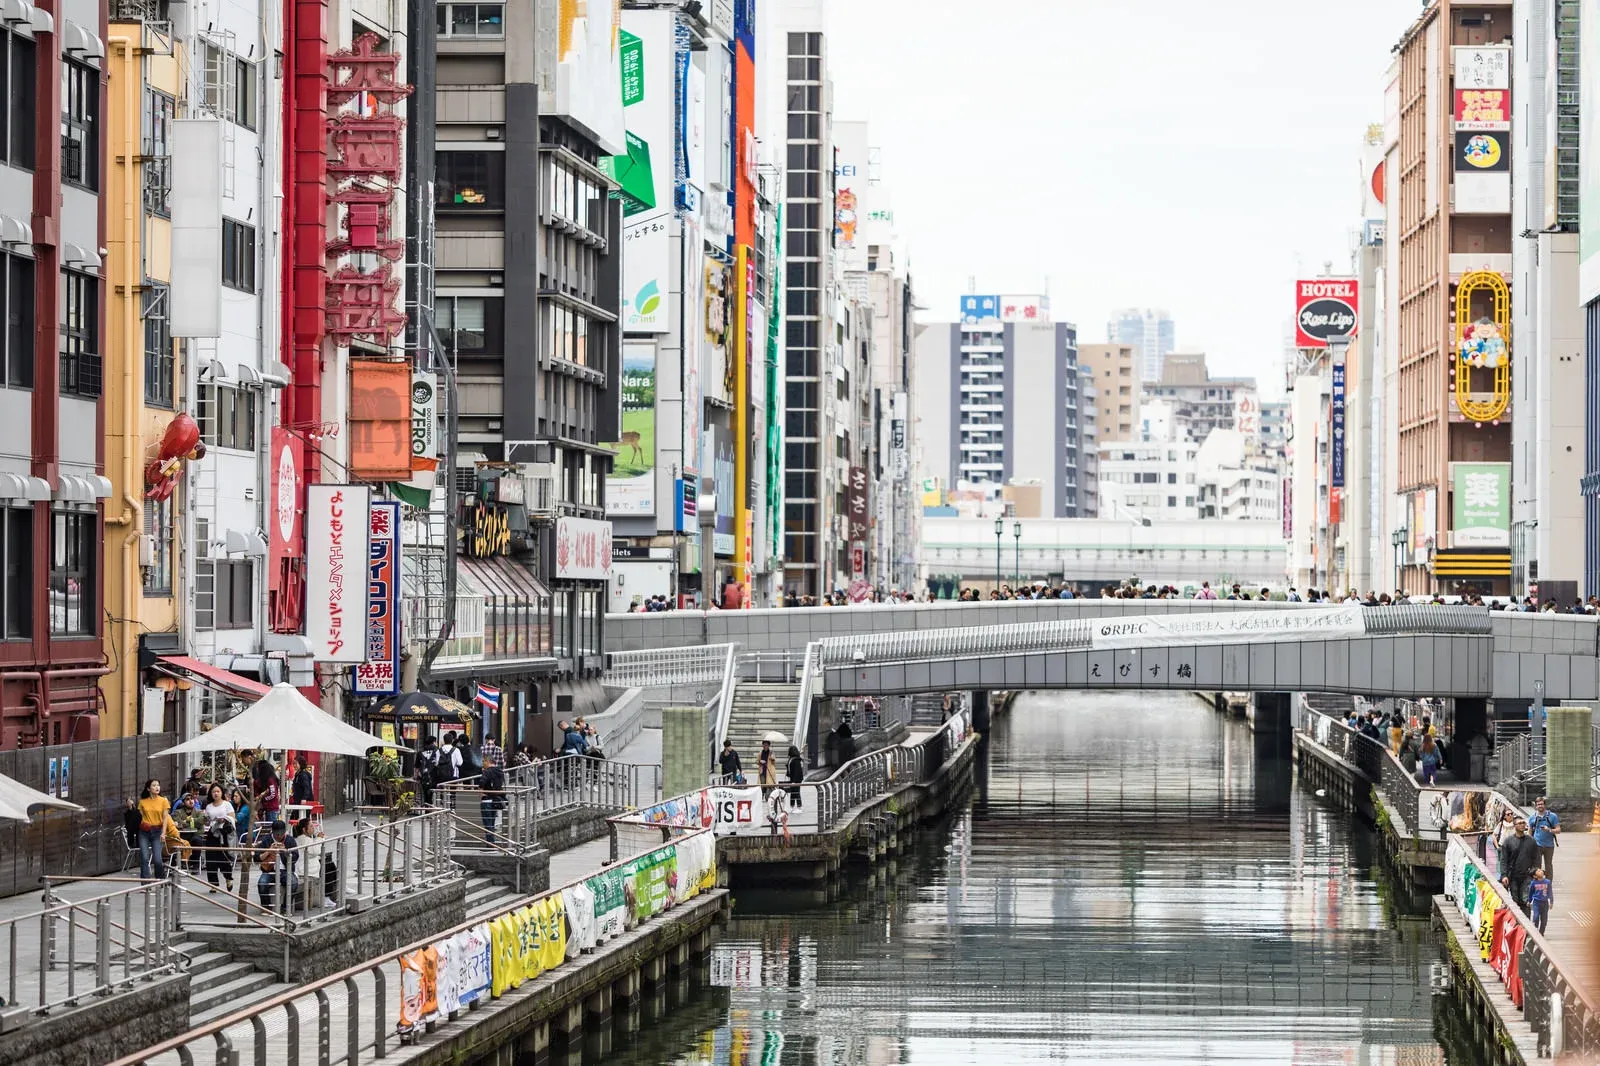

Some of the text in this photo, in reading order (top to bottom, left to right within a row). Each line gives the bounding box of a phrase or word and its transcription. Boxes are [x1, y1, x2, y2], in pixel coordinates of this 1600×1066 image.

[1301, 283, 1354, 297] HOTEL
[1301, 311, 1354, 330] Rose Lips
[327, 491, 344, 656] よしもとエンタメショップ
[370, 540, 389, 618] ダイコク
[357, 663, 393, 679] 免税
[1091, 662, 1192, 679] えびす橋
